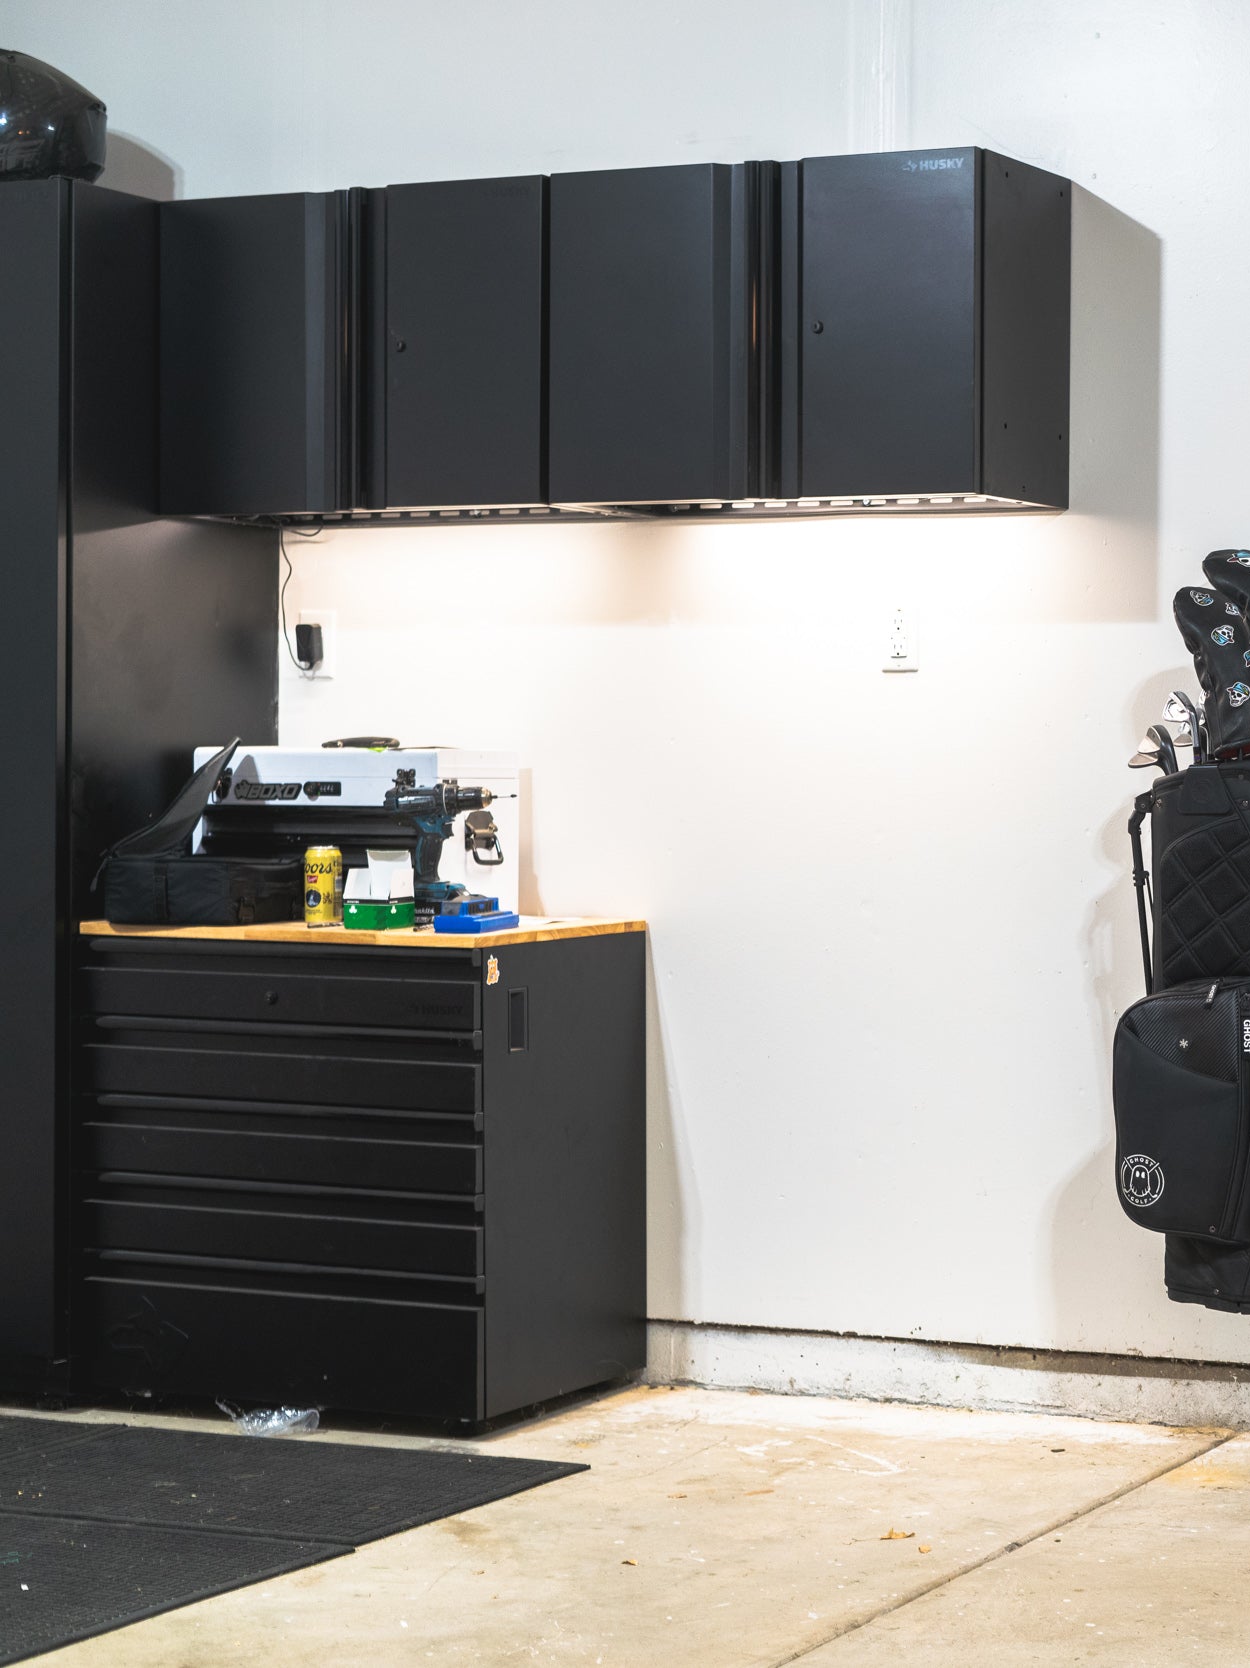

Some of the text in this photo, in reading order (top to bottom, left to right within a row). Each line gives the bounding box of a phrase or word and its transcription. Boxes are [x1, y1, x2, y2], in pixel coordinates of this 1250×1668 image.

[919, 158, 964, 171] HUSKY
[247, 784, 300, 799] BOXO
[304, 861, 332, 874] oors
[1129, 1157, 1154, 1167] GHOST
[1130, 1196, 1148, 1205] GOLF
